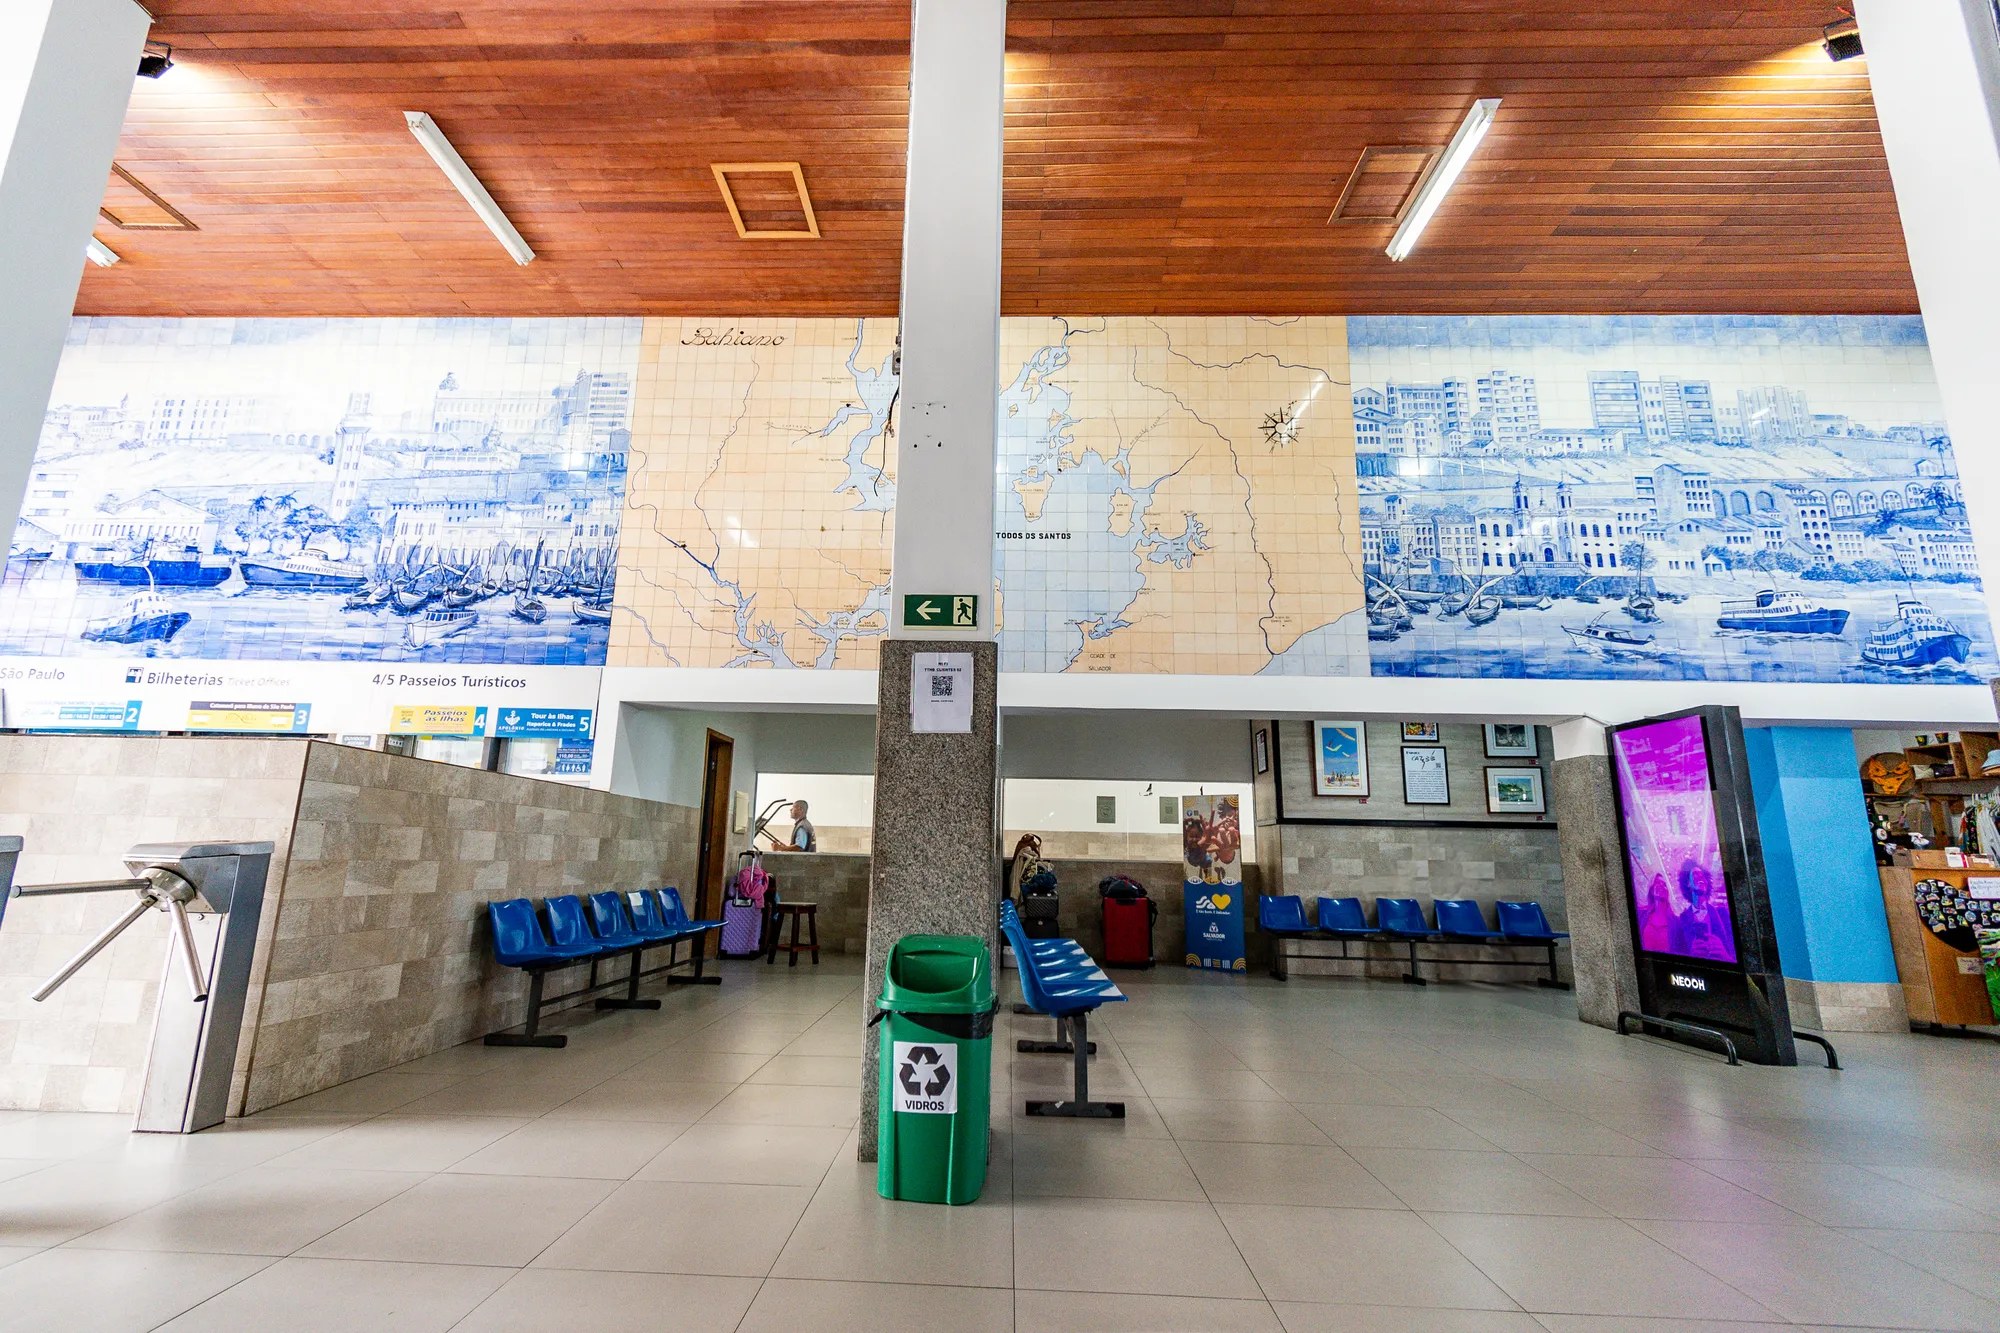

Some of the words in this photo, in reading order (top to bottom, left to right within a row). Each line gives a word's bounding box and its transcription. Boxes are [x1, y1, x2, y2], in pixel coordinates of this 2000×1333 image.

[680, 327, 788, 346] Bahiano
[995, 532, 1024, 540] TODOS
[1026, 532, 1036, 540] OS
[1038, 532, 1072, 540] SANTOS
[0, 667, 24, 680] São
[28, 668, 65, 680] Paulo
[147, 672, 223, 686] Bilheterias
[228, 677, 256, 686] Ticket
[258, 678, 290, 687] Offices
[372, 674, 395, 686] 4/5
[399, 674, 457, 687] Passeios
[462, 675, 526, 688] Turísticos
[126, 708, 138, 722] 2
[296, 710, 308, 725] 3
[474, 714, 485, 729] 4
[579, 716, 590, 731] 5
[1672, 974, 1706, 991] NEOOH
[905, 1100, 944, 1111] VIDROS
